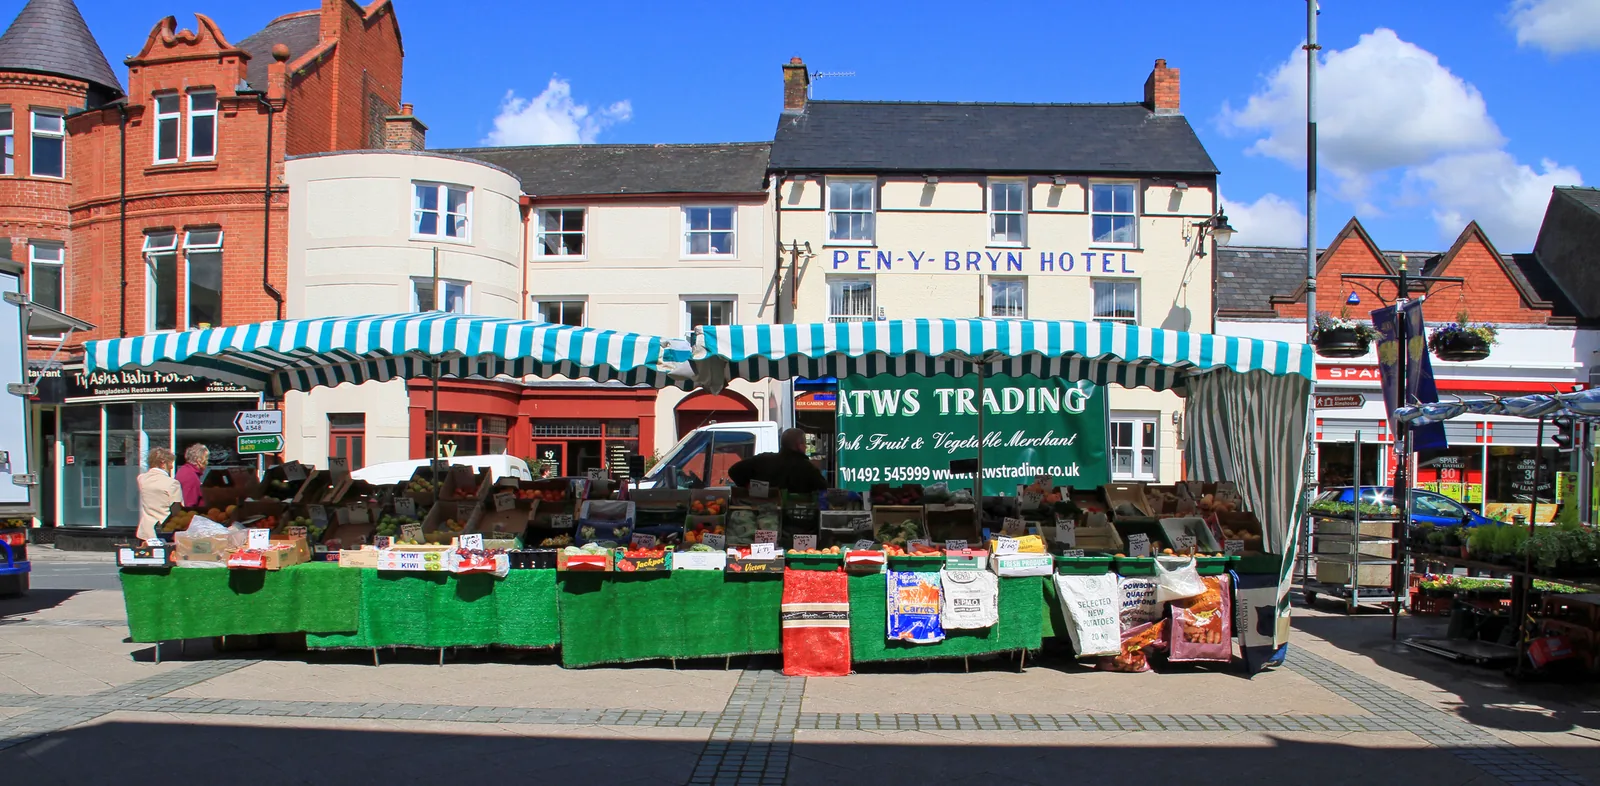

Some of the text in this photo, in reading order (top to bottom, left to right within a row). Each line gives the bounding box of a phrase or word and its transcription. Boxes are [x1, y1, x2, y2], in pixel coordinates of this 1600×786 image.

[832, 250, 1136, 274] PEN-Y-BRYN HOTEL
[90, 372, 119, 385] Asha
[94, 387, 130, 395] Bangladeshi
[933, 387, 1088, 417] TRADING
[866, 433, 910, 451] Fruit
[911, 437, 924, 450] &
[932, 430, 1002, 454] Vegetable
[1004, 430, 1078, 447] Merchant
[884, 466, 930, 481] 545999
[932, 462, 1080, 480] www.ttwstrading.co.uk
[1440, 468, 1456, 479] 30
[635, 557, 664, 571] Jackpot
[744, 562, 767, 572] Victory
[1003, 558, 1048, 568] FRESH PRODUCE
[1077, 597, 1112, 609] SELECTED
[903, 605, 935, 614] Carrots
[1087, 609, 1104, 618] NEW
[1083, 616, 1115, 628] POTATOES
